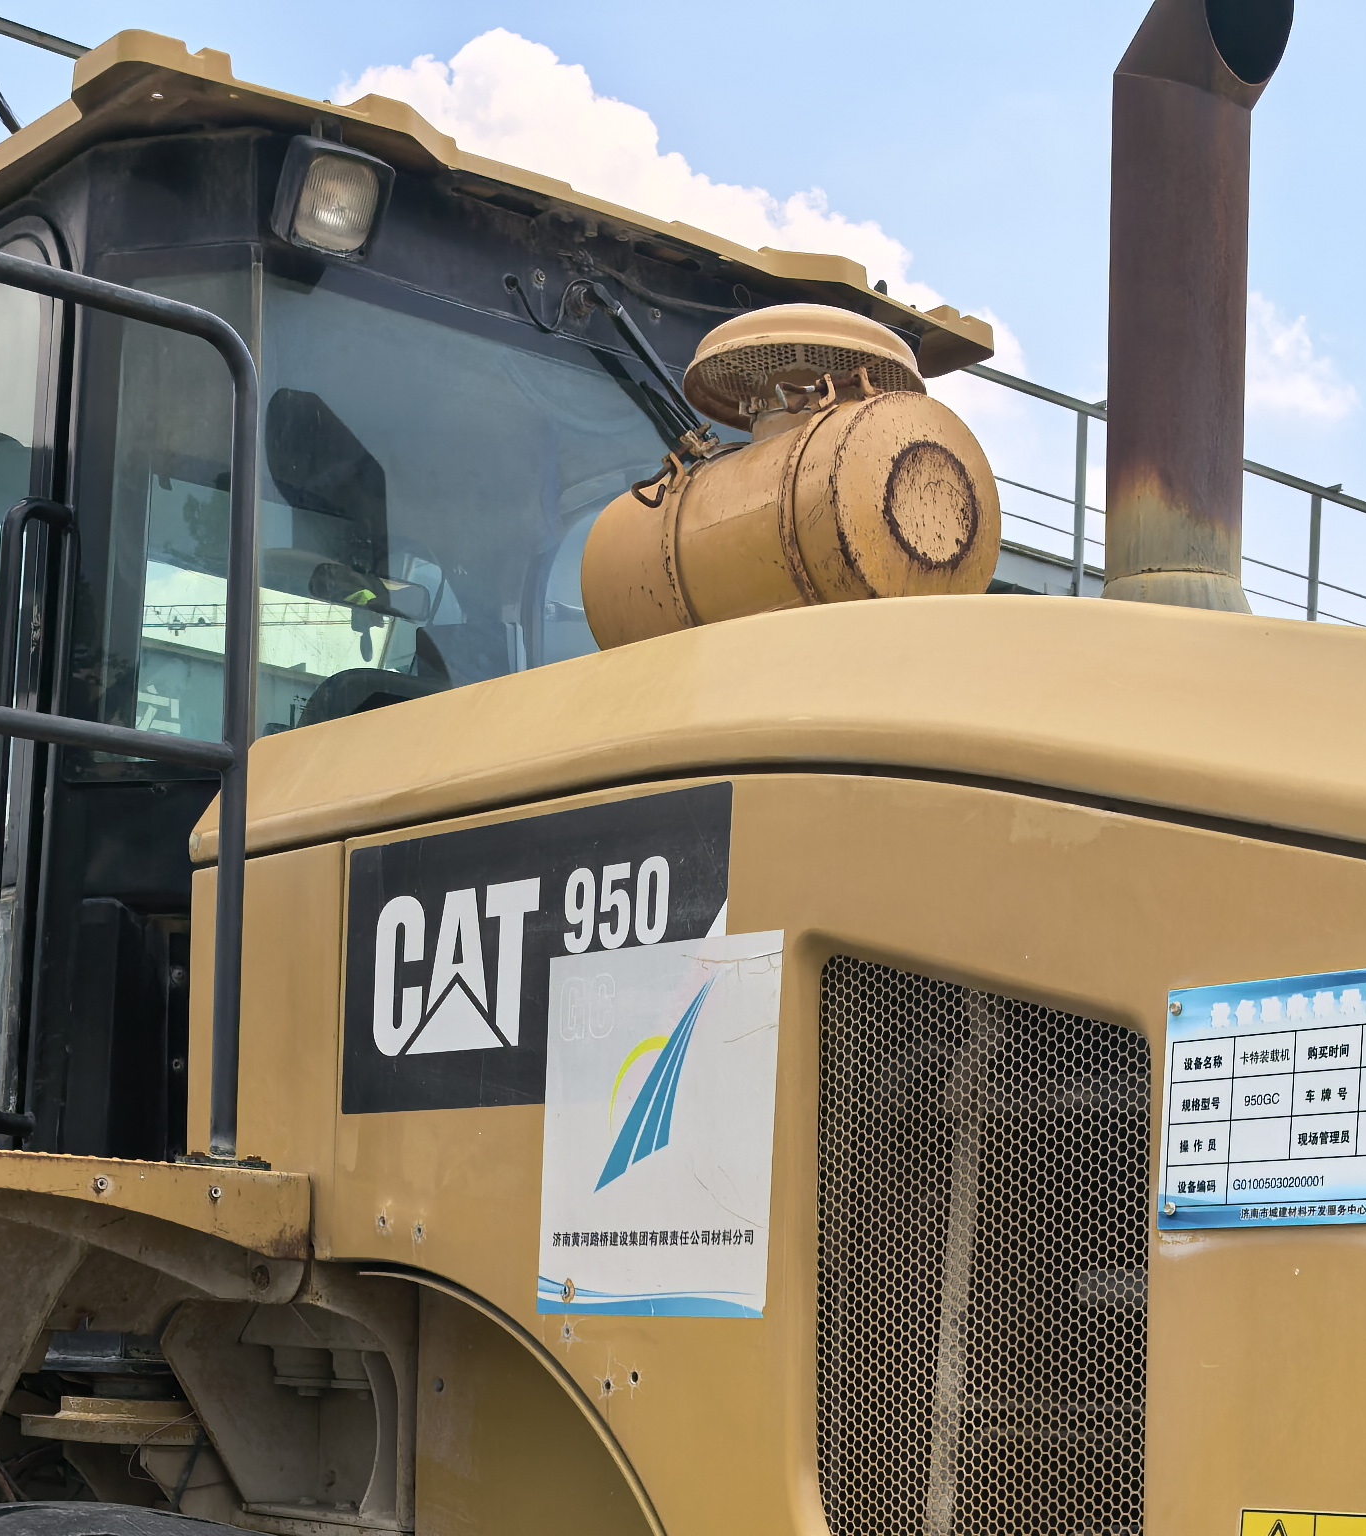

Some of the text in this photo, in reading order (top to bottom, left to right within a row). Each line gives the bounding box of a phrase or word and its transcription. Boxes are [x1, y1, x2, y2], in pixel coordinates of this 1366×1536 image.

[373, 855, 670, 1057] CAT 950
[560, 972, 616, 1042] GC
[1240, 1048, 1290, 1065] 卡特装载机
[1308, 1044, 1350, 1059] 购买时间
[1184, 1055, 1223, 1070] 设备名称
[1244, 1092, 1280, 1107] 950GC
[1305, 1087, 1348, 1103] 车牌号
[1182, 1097, 1220, 1112] 规格型号
[1180, 1138, 1217, 1153] 操作员
[1298, 1131, 1350, 1146] 现场管理员
[1178, 1180, 1216, 1194] 设备编码
[1233, 1175, 1325, 1191] G01005030200001
[552, 1229, 755, 1248] 济南黄河路桥建设集团有限责任公司材料分司
